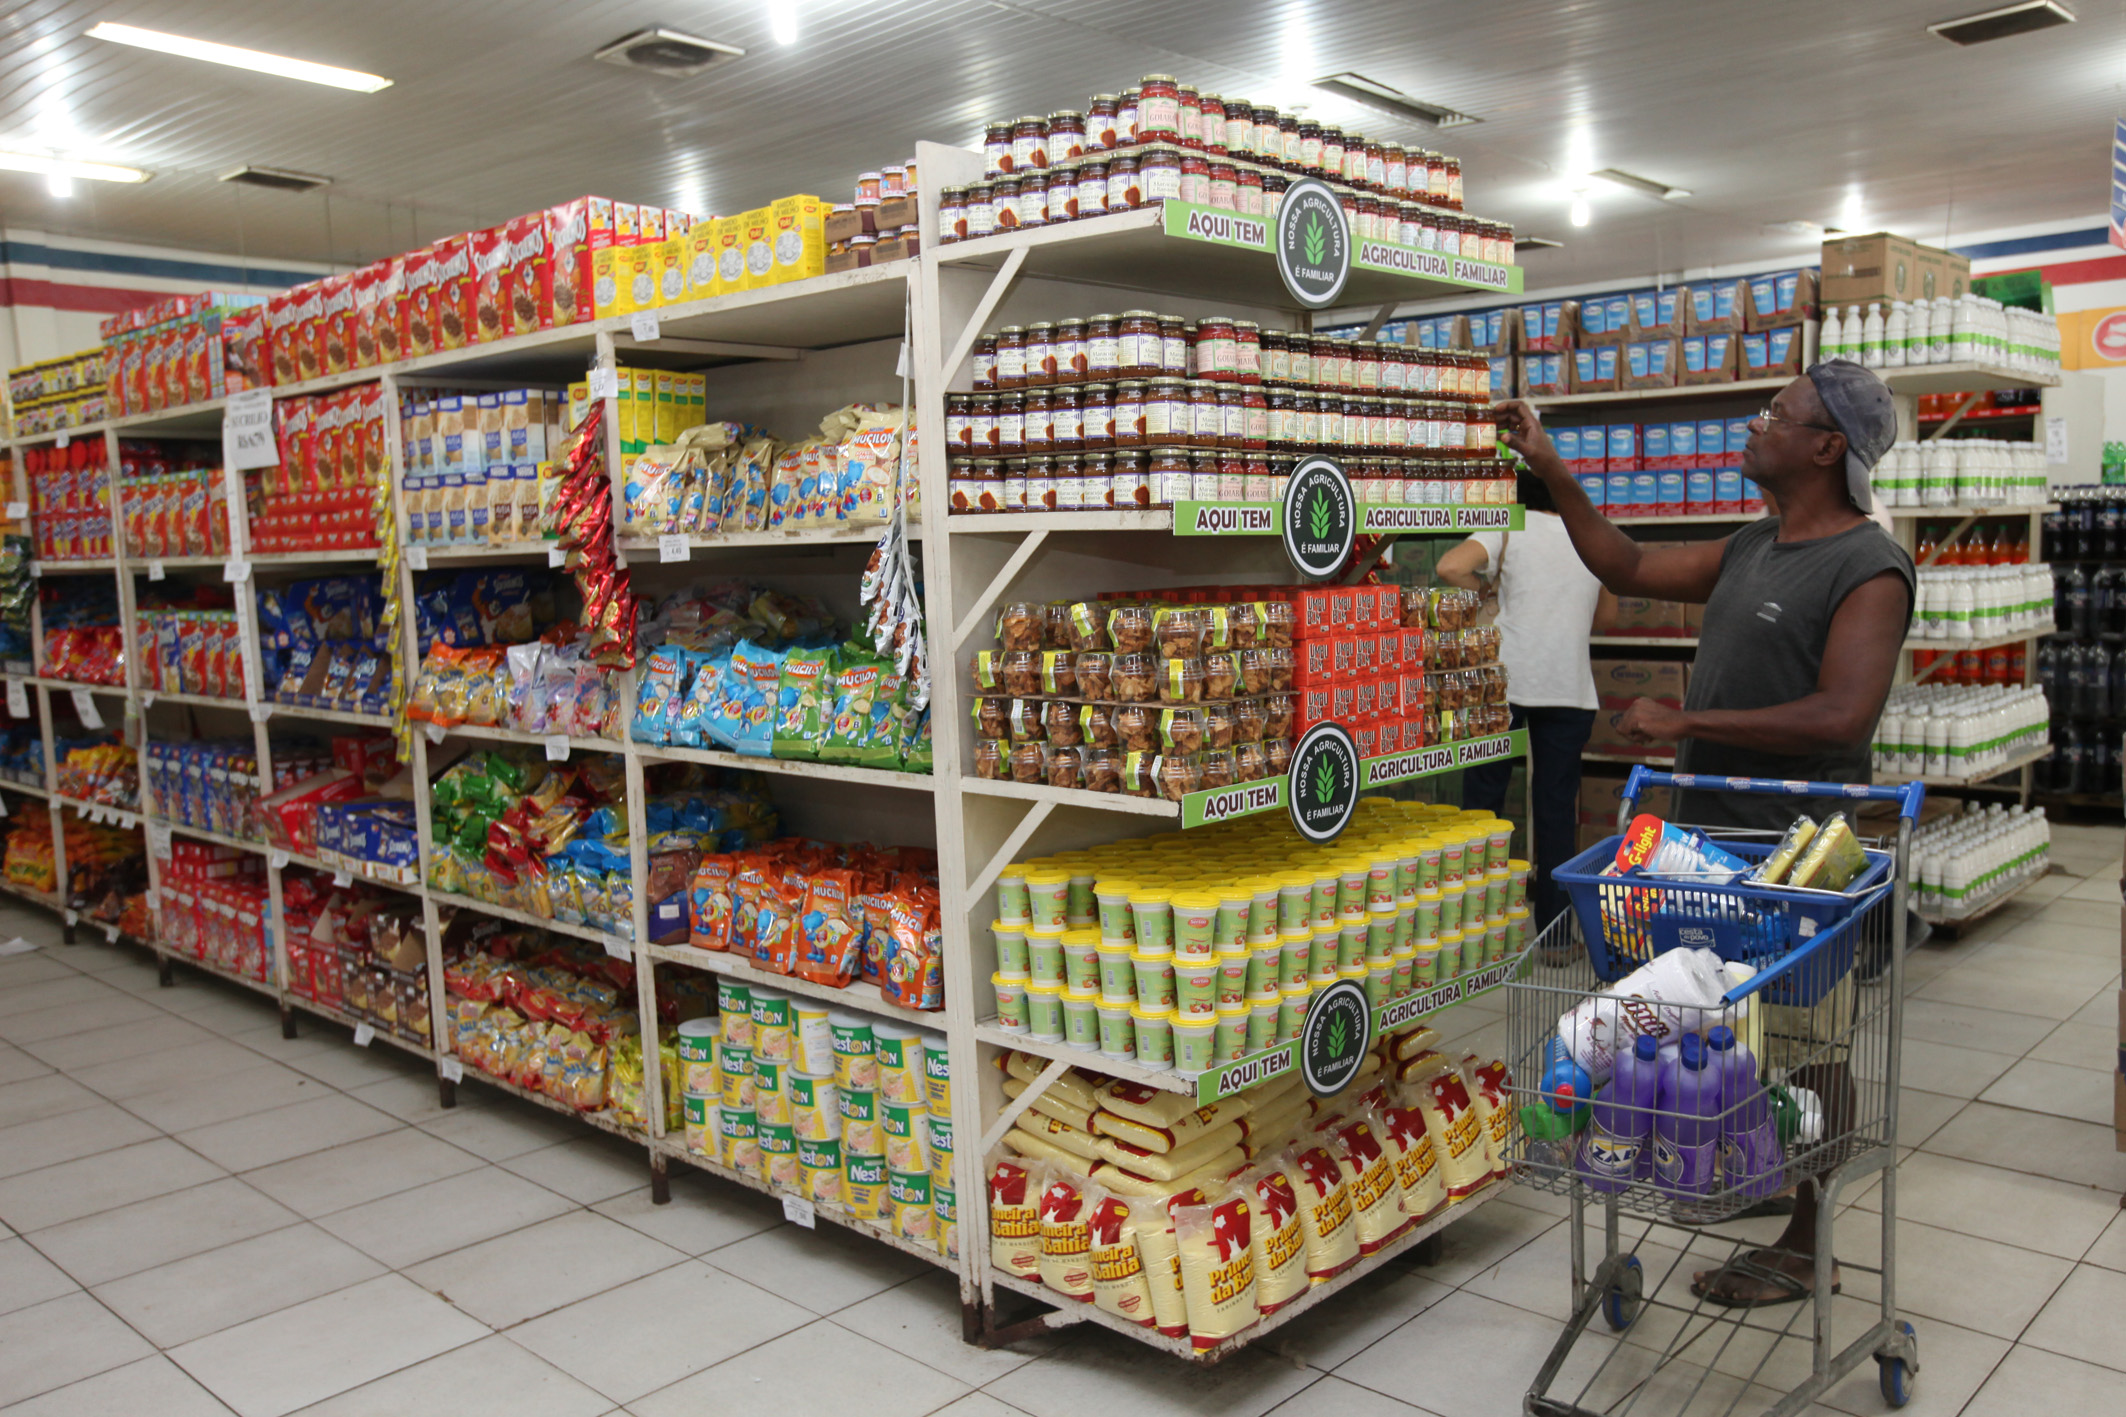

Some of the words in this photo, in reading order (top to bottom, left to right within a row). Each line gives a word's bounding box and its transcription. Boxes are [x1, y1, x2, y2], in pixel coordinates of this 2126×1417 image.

[1189, 211, 1229, 239] AQUI
[1234, 221, 1265, 244] TEM
[1289, 208, 1301, 250] NOSSA
[1303, 197, 1340, 257] AGRICULTURA
[1360, 244, 1448, 276] AGRICULTURA
[1454, 261, 1507, 287] FAMILIAR
[1295, 265, 1301, 277] É
[1301, 268, 1334, 283] FAMILIAR
[851, 432, 895, 446] MUCILON
[1294, 487, 1308, 529] NOSSA
[1308, 474, 1345, 528] AGRICULTURA
[1197, 509, 1237, 532] AQUI
[1242, 508, 1271, 528] TEM
[1365, 508, 1451, 528] AGRICULTURA
[1457, 508, 1509, 527] FAMILIAR
[1301, 542, 1306, 554] É
[1307, 543, 1340, 554] FAMILIAR
[1307, 596, 1326, 611] UMBU
[1332, 595, 1352, 611] UMBU
[1356, 593, 1375, 609] UMBU
[1380, 592, 1397, 606] UMBU
[1307, 611, 1320, 626] BOM
[1332, 610, 1346, 624] BOM
[1356, 607, 1369, 622] BOM
[1380, 606, 1393, 620] BOM
[1335, 641, 1354, 657] UMBU
[1356, 639, 1375, 654] UMBU
[1380, 636, 1398, 651] UMBU
[1403, 634, 1420, 648] UMBU
[1309, 643, 1328, 659] UMBU
[1380, 650, 1393, 664] BOM
[1403, 647, 1416, 662] BOM
[1309, 658, 1323, 673] BOM
[1335, 656, 1349, 670] BOM
[1357, 653, 1370, 668] BOM
[1358, 685, 1375, 700] UMBU
[1379, 682, 1397, 696] UMBU
[1404, 678, 1421, 692] UMBU
[1307, 691, 1328, 706] UMBU
[1334, 688, 1353, 703] UMBU
[1379, 695, 1392, 709] BOM
[1405, 691, 1417, 705] BOM
[1307, 705, 1322, 721] BOM
[1334, 702, 1348, 717] BOM
[1358, 699, 1370, 713] BOM
[1380, 725, 1398, 740] UMBU
[1403, 721, 1421, 735] UMBU
[1356, 729, 1375, 745] UMBU
[1403, 735, 1416, 749] BOM
[1356, 744, 1370, 757] BOM
[1381, 739, 1393, 753] BOM
[1368, 749, 1453, 783] AGRICULTURA
[1458, 737, 1511, 762] FAMILIAR
[1300, 755, 1313, 798] NOSSA
[1314, 742, 1349, 789] AGRICULTURA
[1204, 791, 1245, 820] AQUI
[1248, 786, 1277, 807] TEM
[1307, 808, 1311, 821] É
[1312, 804, 1344, 819] FAMILIAR
[1628, 826, 1657, 866] G-light
[1378, 982, 1461, 1031] AGRICULTURA
[1312, 1015, 1326, 1057] NOSSA
[1327, 996, 1361, 1040] AGRICULTURA
[1218, 1062, 1258, 1095] AQUI
[1262, 1049, 1290, 1075] TEM
[1317, 1065, 1322, 1078] É
[1323, 1056, 1354, 1076] FAMILIAR
[1491, 1125, 1505, 1142] da
[1449, 1139, 1465, 1158] da
[850, 1165, 889, 1182] Nesto
[1400, 1168, 1418, 1189] da
[1355, 1187, 1375, 1212] da
[993, 1220, 1041, 1237] Bahia
[1318, 1217, 1335, 1237] da
[1043, 1236, 1090, 1255] Bahia
[1268, 1247, 1286, 1271] da
[1094, 1256, 1141, 1281] Bahia
[1211, 1282, 1233, 1305] da
